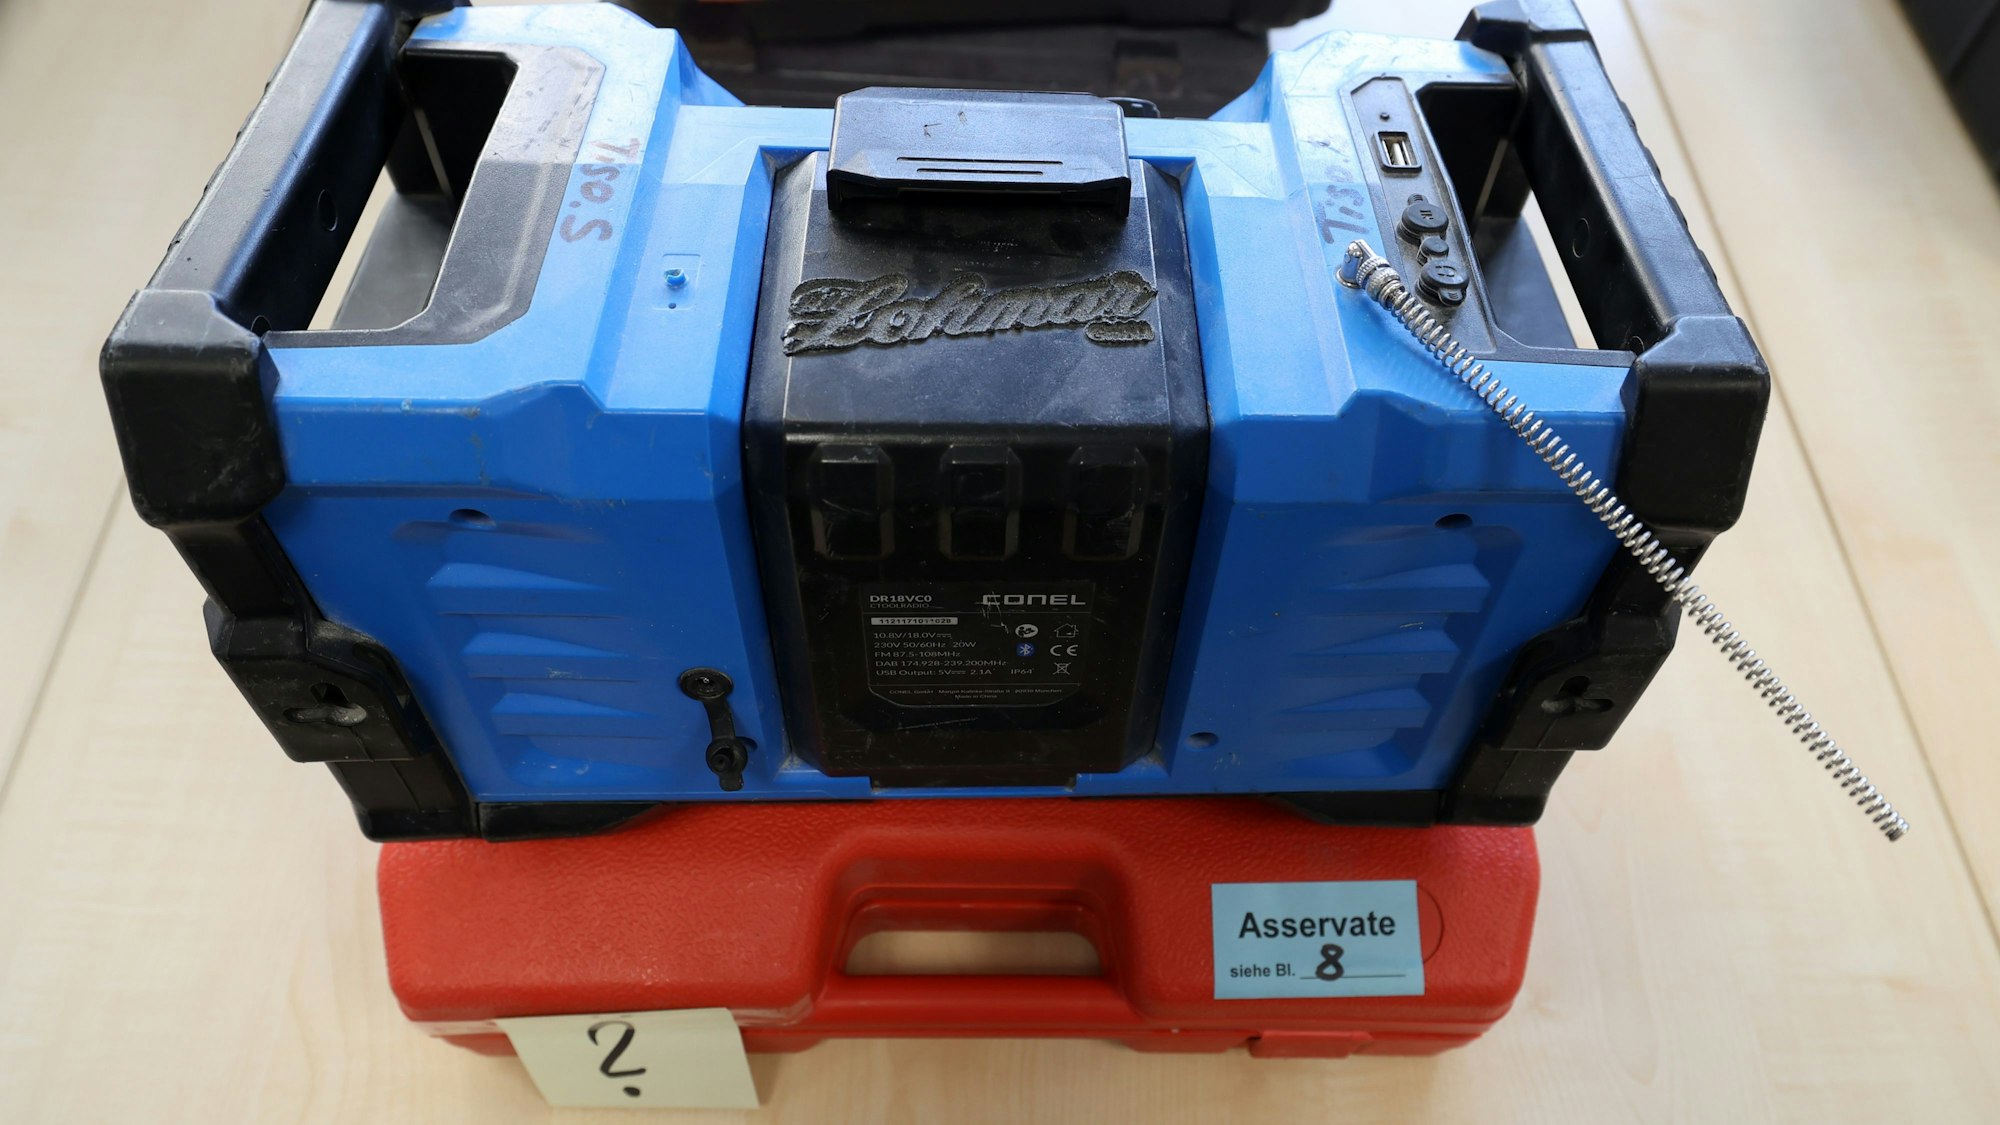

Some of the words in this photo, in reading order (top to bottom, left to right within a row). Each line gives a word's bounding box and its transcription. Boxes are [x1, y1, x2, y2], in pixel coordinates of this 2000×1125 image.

[982, 594, 1086, 606] CONEL
[874, 632, 936, 640] 10.8V/18.0V
[898, 669, 936, 677] Output:
[1238, 911, 1396, 938] Asservate
[1315, 943, 1345, 981] 8
[1230, 964, 1271, 978] siehe
[1276, 963, 1296, 977] Bl.
